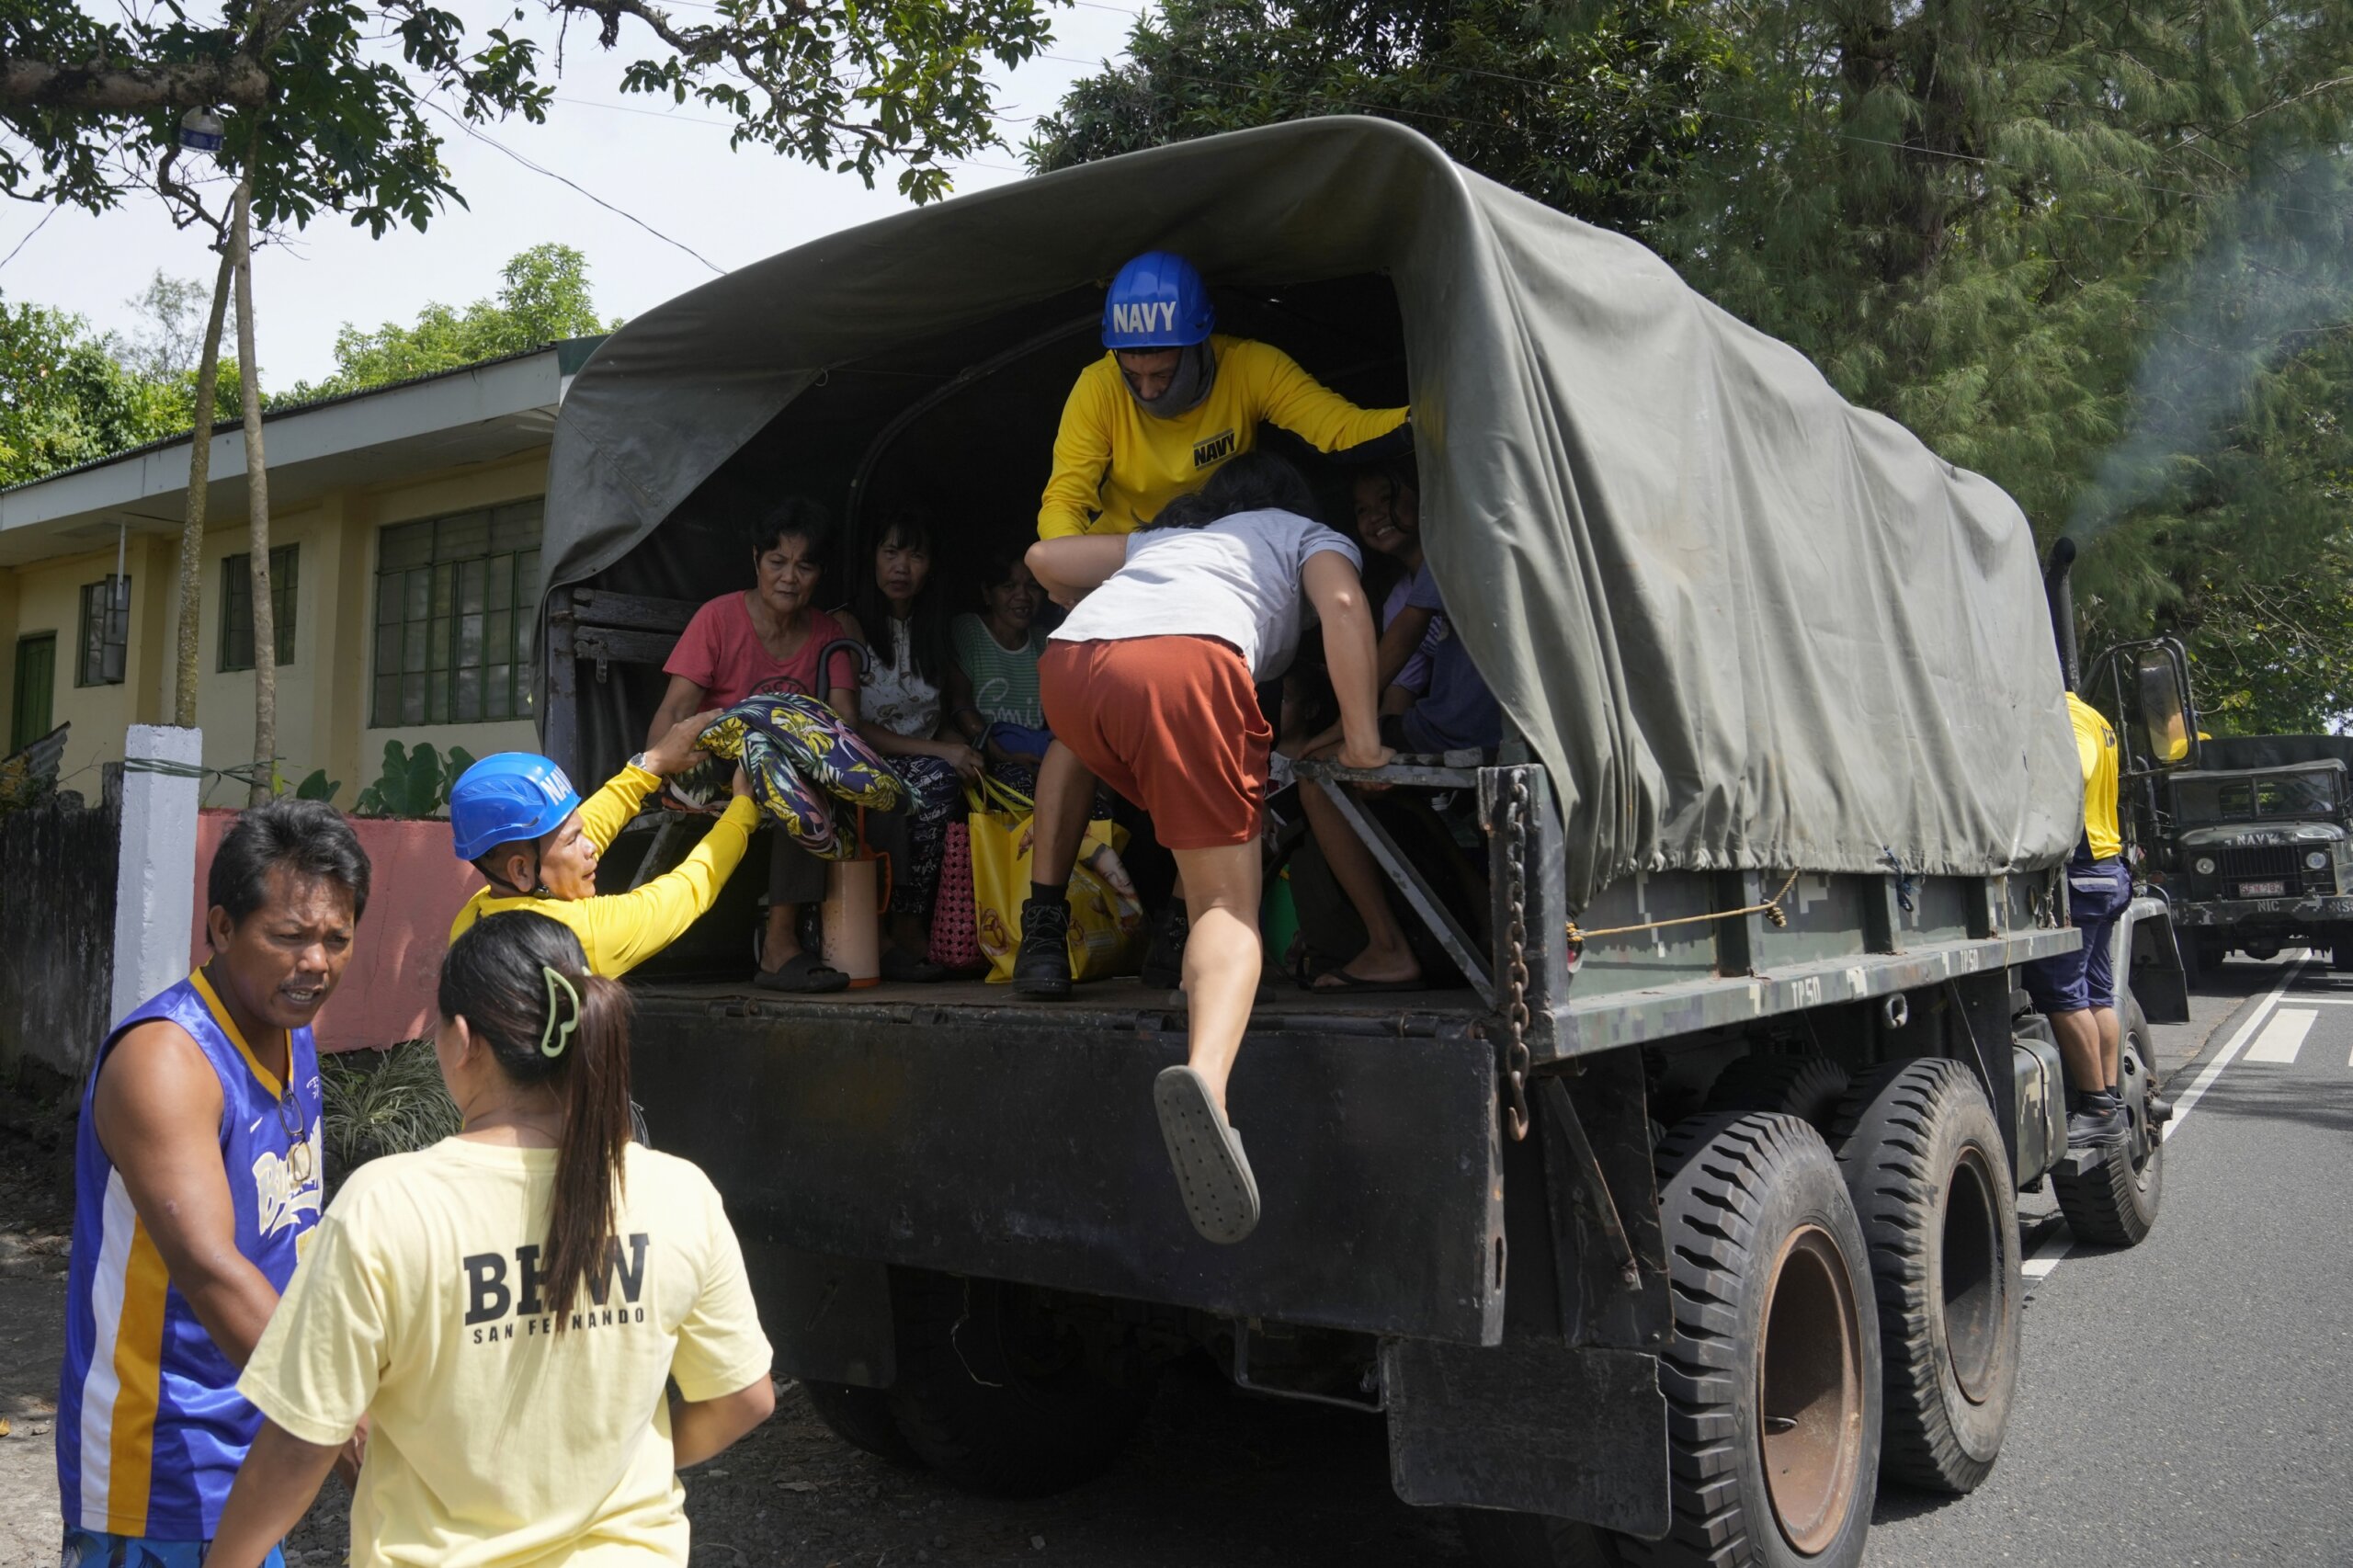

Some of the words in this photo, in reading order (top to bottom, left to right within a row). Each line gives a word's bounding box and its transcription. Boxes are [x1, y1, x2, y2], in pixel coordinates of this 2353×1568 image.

[1113, 301, 1176, 333] NAVY
[1193, 432, 1235, 466] NAVY
[975, 676, 1044, 730] Smil
[540, 765, 574, 806] NAV
[2236, 833, 2274, 846] NAVY
[2257, 901, 2279, 913] NIC
[473, 1324, 514, 1344] SAN
[529, 1307, 645, 1335] FENANDO
